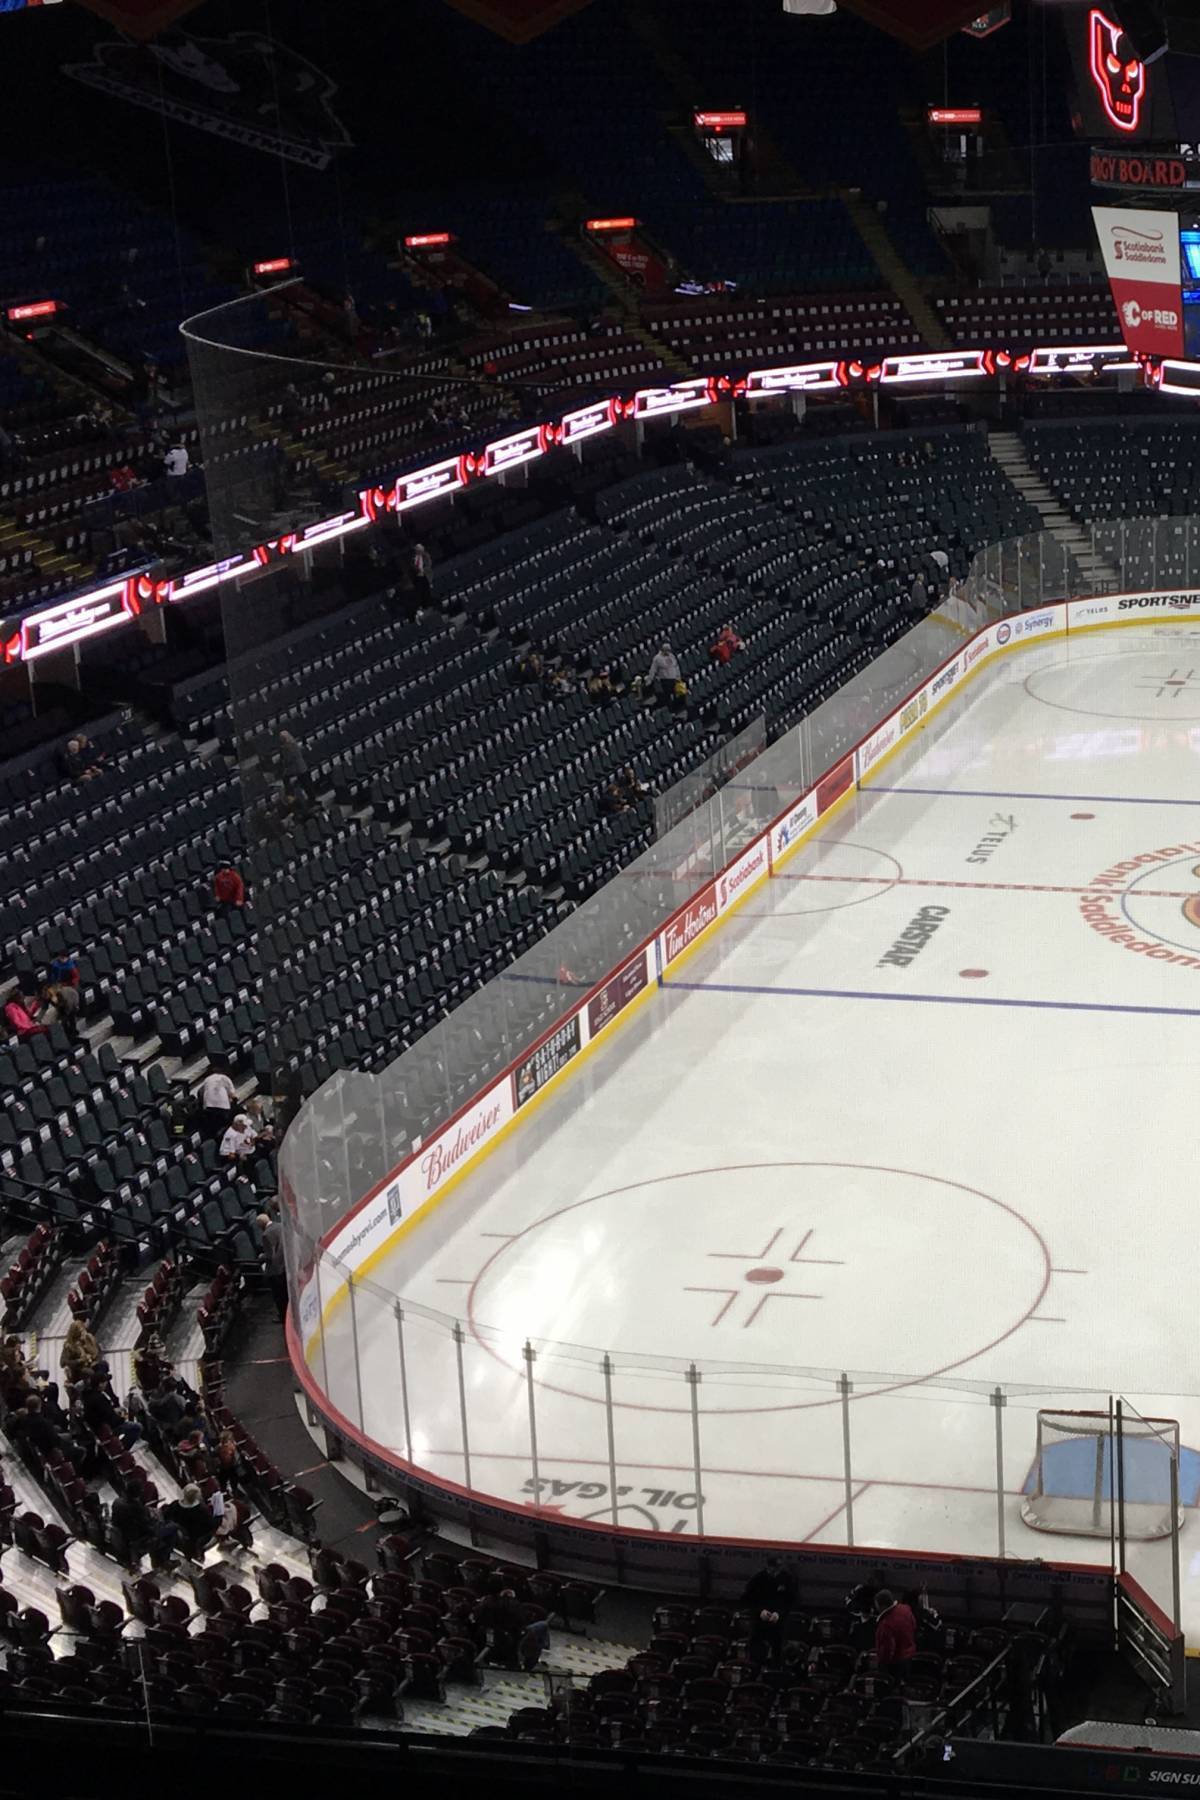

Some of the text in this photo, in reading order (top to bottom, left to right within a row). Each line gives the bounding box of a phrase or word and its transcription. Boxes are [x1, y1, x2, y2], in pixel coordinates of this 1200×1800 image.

[1119, 160, 1186, 185] BOARD
[1123, 241, 1165, 253] Scotiabank
[1154, 309, 1178, 326] RED
[1024, 616, 1054, 632] Synergy
[965, 831, 1008, 865] TELUS
[728, 850, 765, 893] Scotiabank
[666, 903, 717, 960] Tim Hortons
[421, 1103, 501, 1190] Budweiser
[519, 1477, 707, 1511] OIL & GAS
[1148, 1769, 1182, 1785] SIGN
